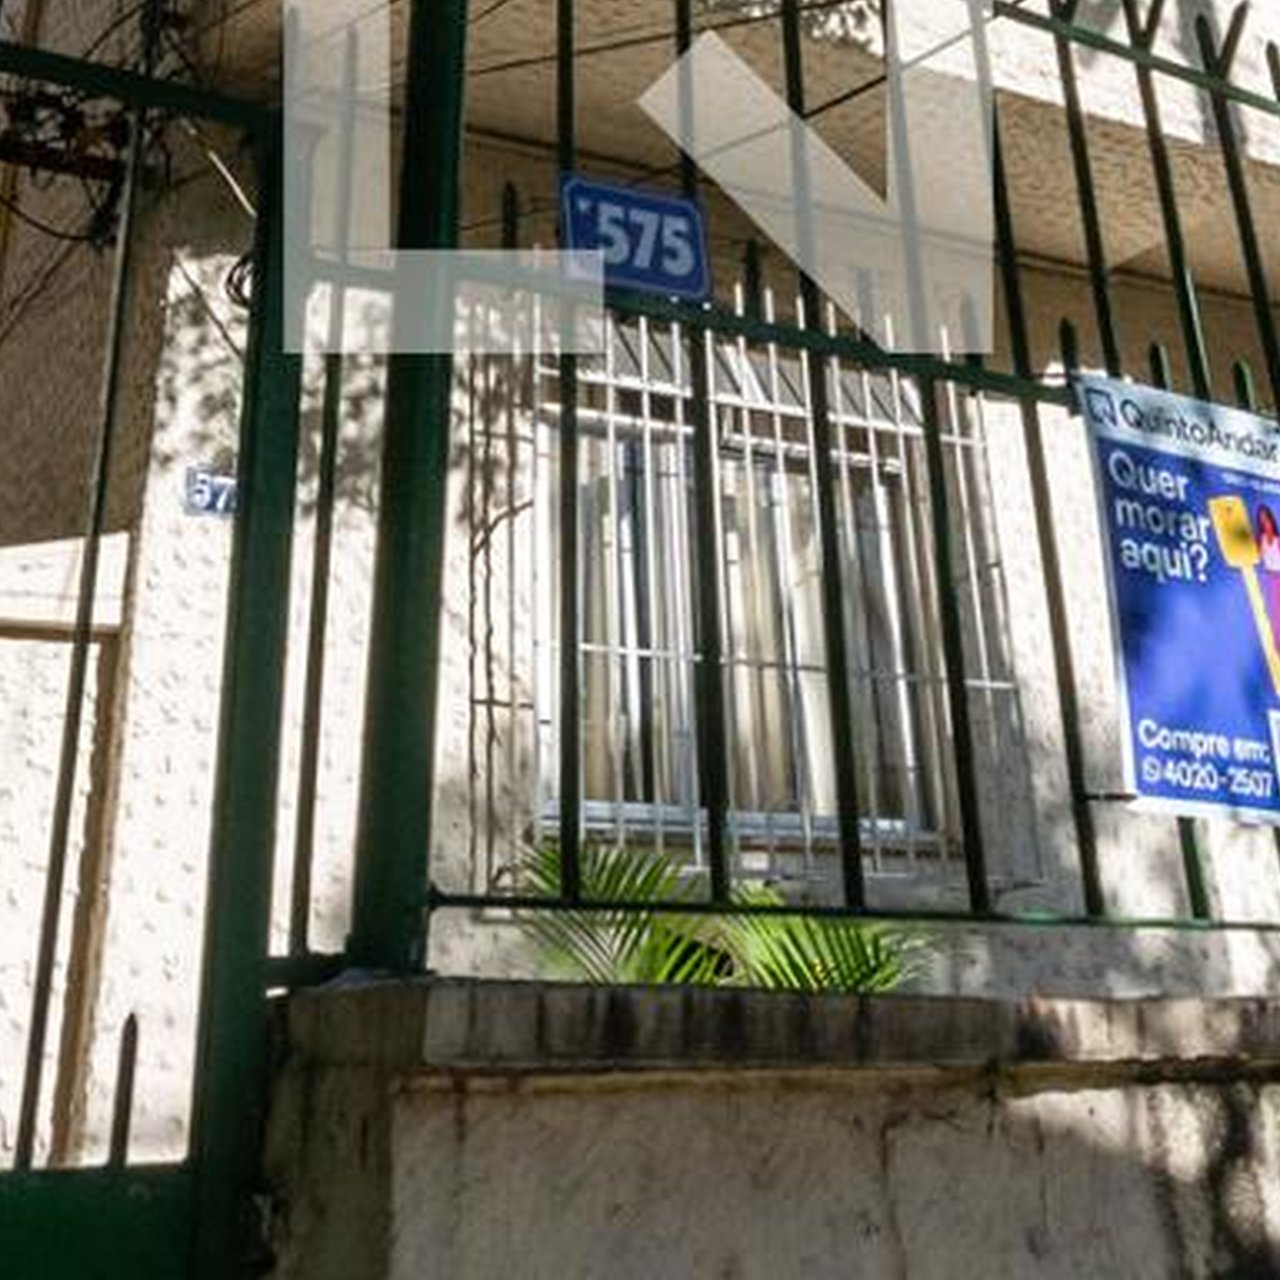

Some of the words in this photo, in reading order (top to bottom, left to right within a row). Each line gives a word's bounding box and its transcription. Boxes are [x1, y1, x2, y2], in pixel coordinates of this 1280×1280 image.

[596, 202, 695, 277] 575
[1121, 398, 1279, 464] QuintoAndar
[191, 472, 237, 510] 57
[1108, 450, 1189, 501] Quer
[1115, 497, 1210, 544] morar
[1120, 538, 1209, 584] aqui?
[1138, 718, 1230, 760] Compre
